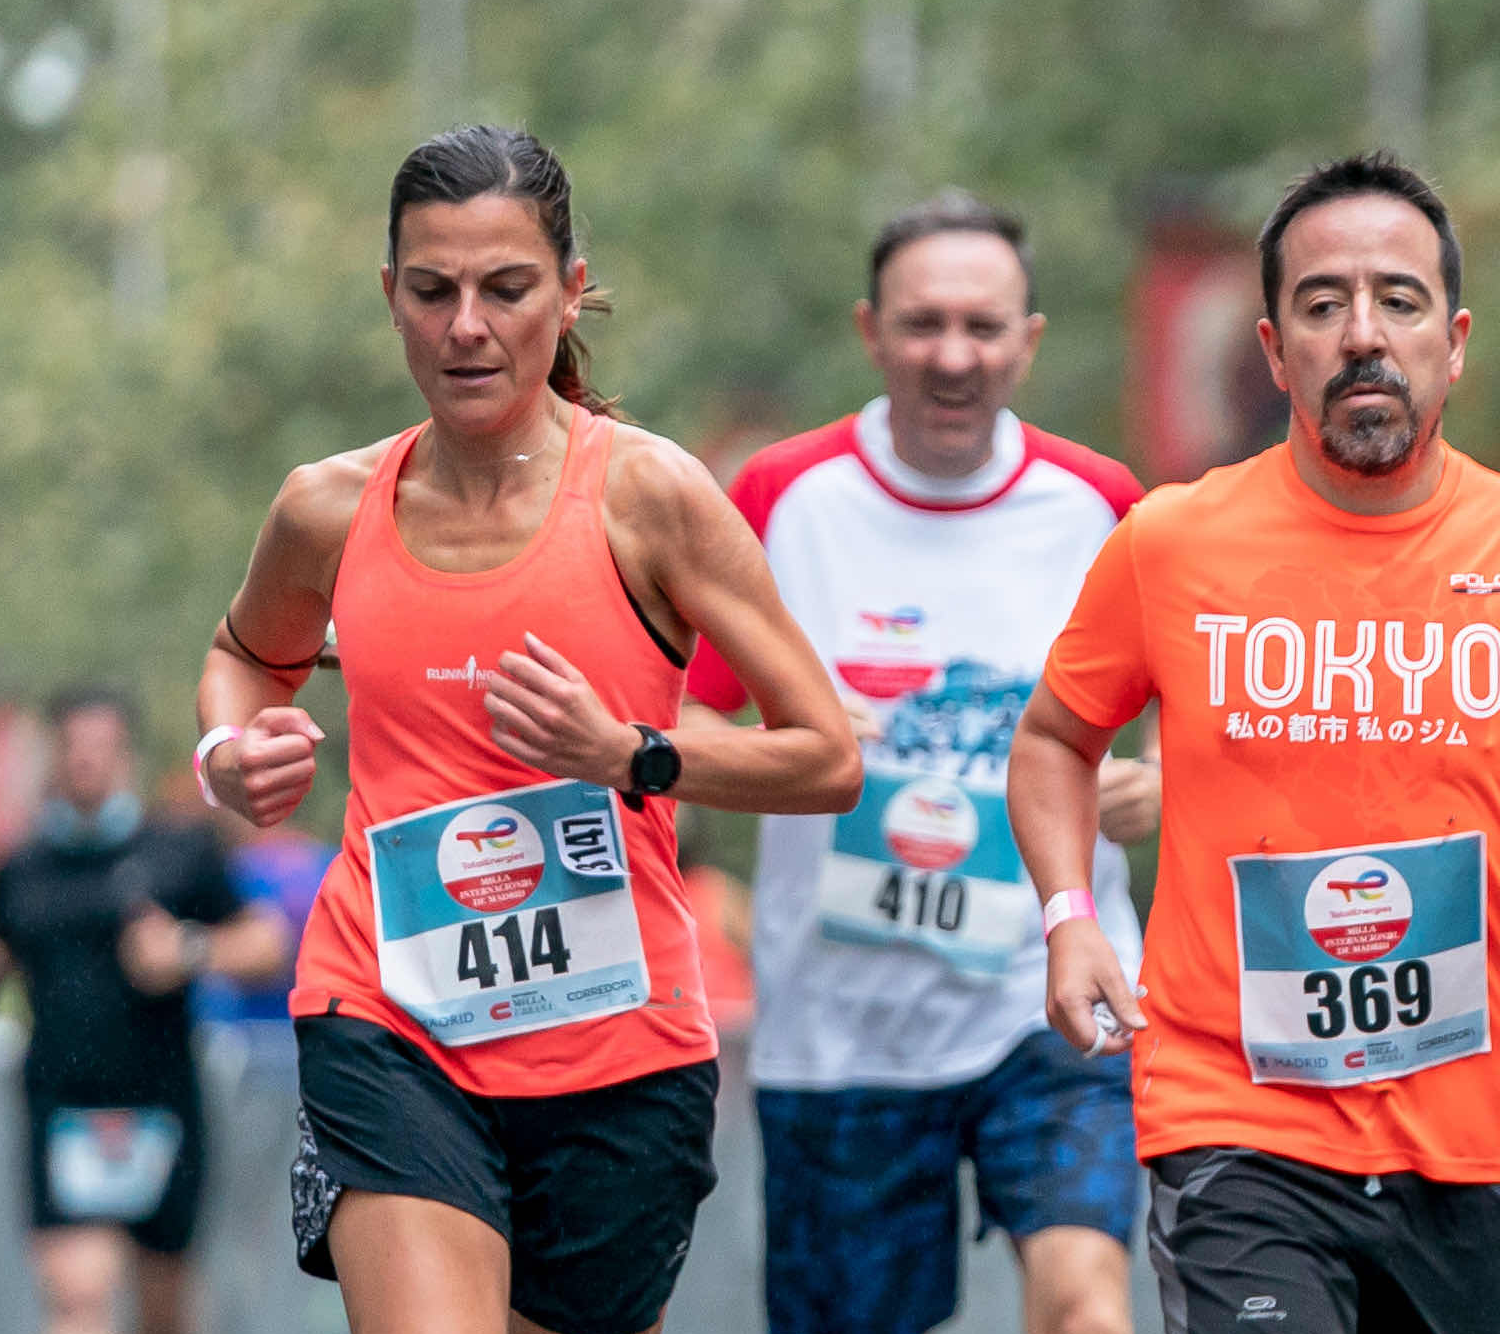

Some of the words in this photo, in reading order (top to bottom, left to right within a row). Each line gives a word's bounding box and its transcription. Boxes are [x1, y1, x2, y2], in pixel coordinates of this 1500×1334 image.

[1225, 712, 1348, 744] 私の都市
[1357, 716, 1469, 746] 私のジム
[562, 818, 614, 871] 3147
[874, 870, 966, 932] 410
[457, 907, 572, 989] 414
[1303, 959, 1432, 1039] 369
